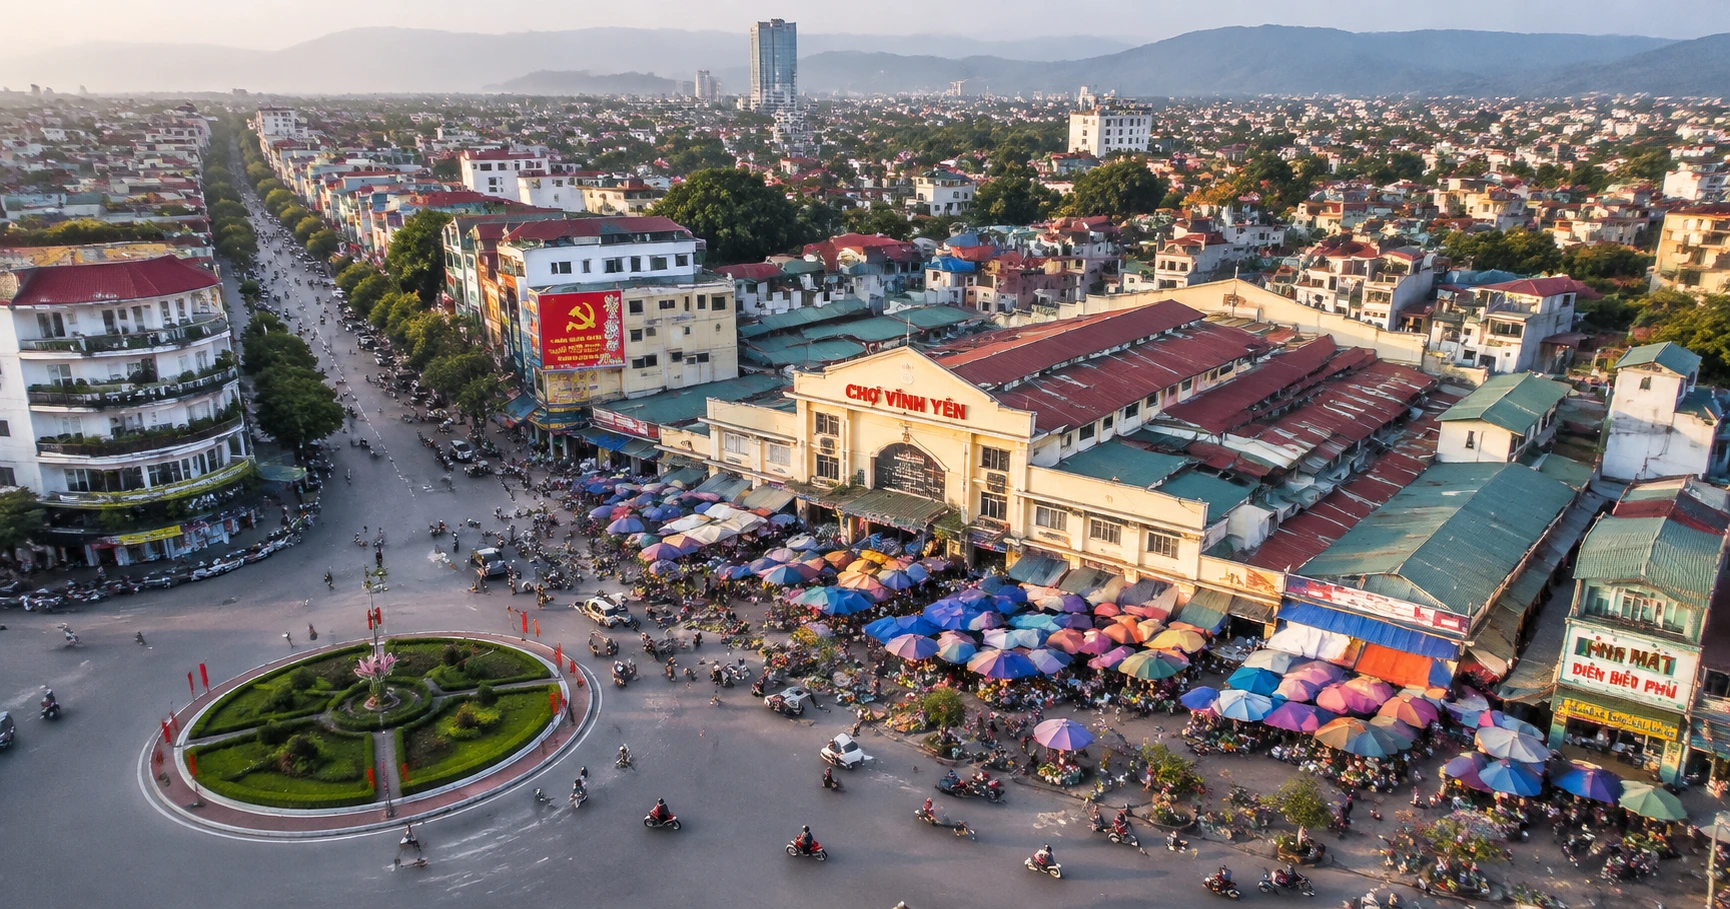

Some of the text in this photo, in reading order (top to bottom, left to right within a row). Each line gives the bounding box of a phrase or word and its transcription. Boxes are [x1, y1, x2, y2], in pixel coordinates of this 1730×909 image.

[846, 384, 966, 420] CHỢ VĨNH YÊN
